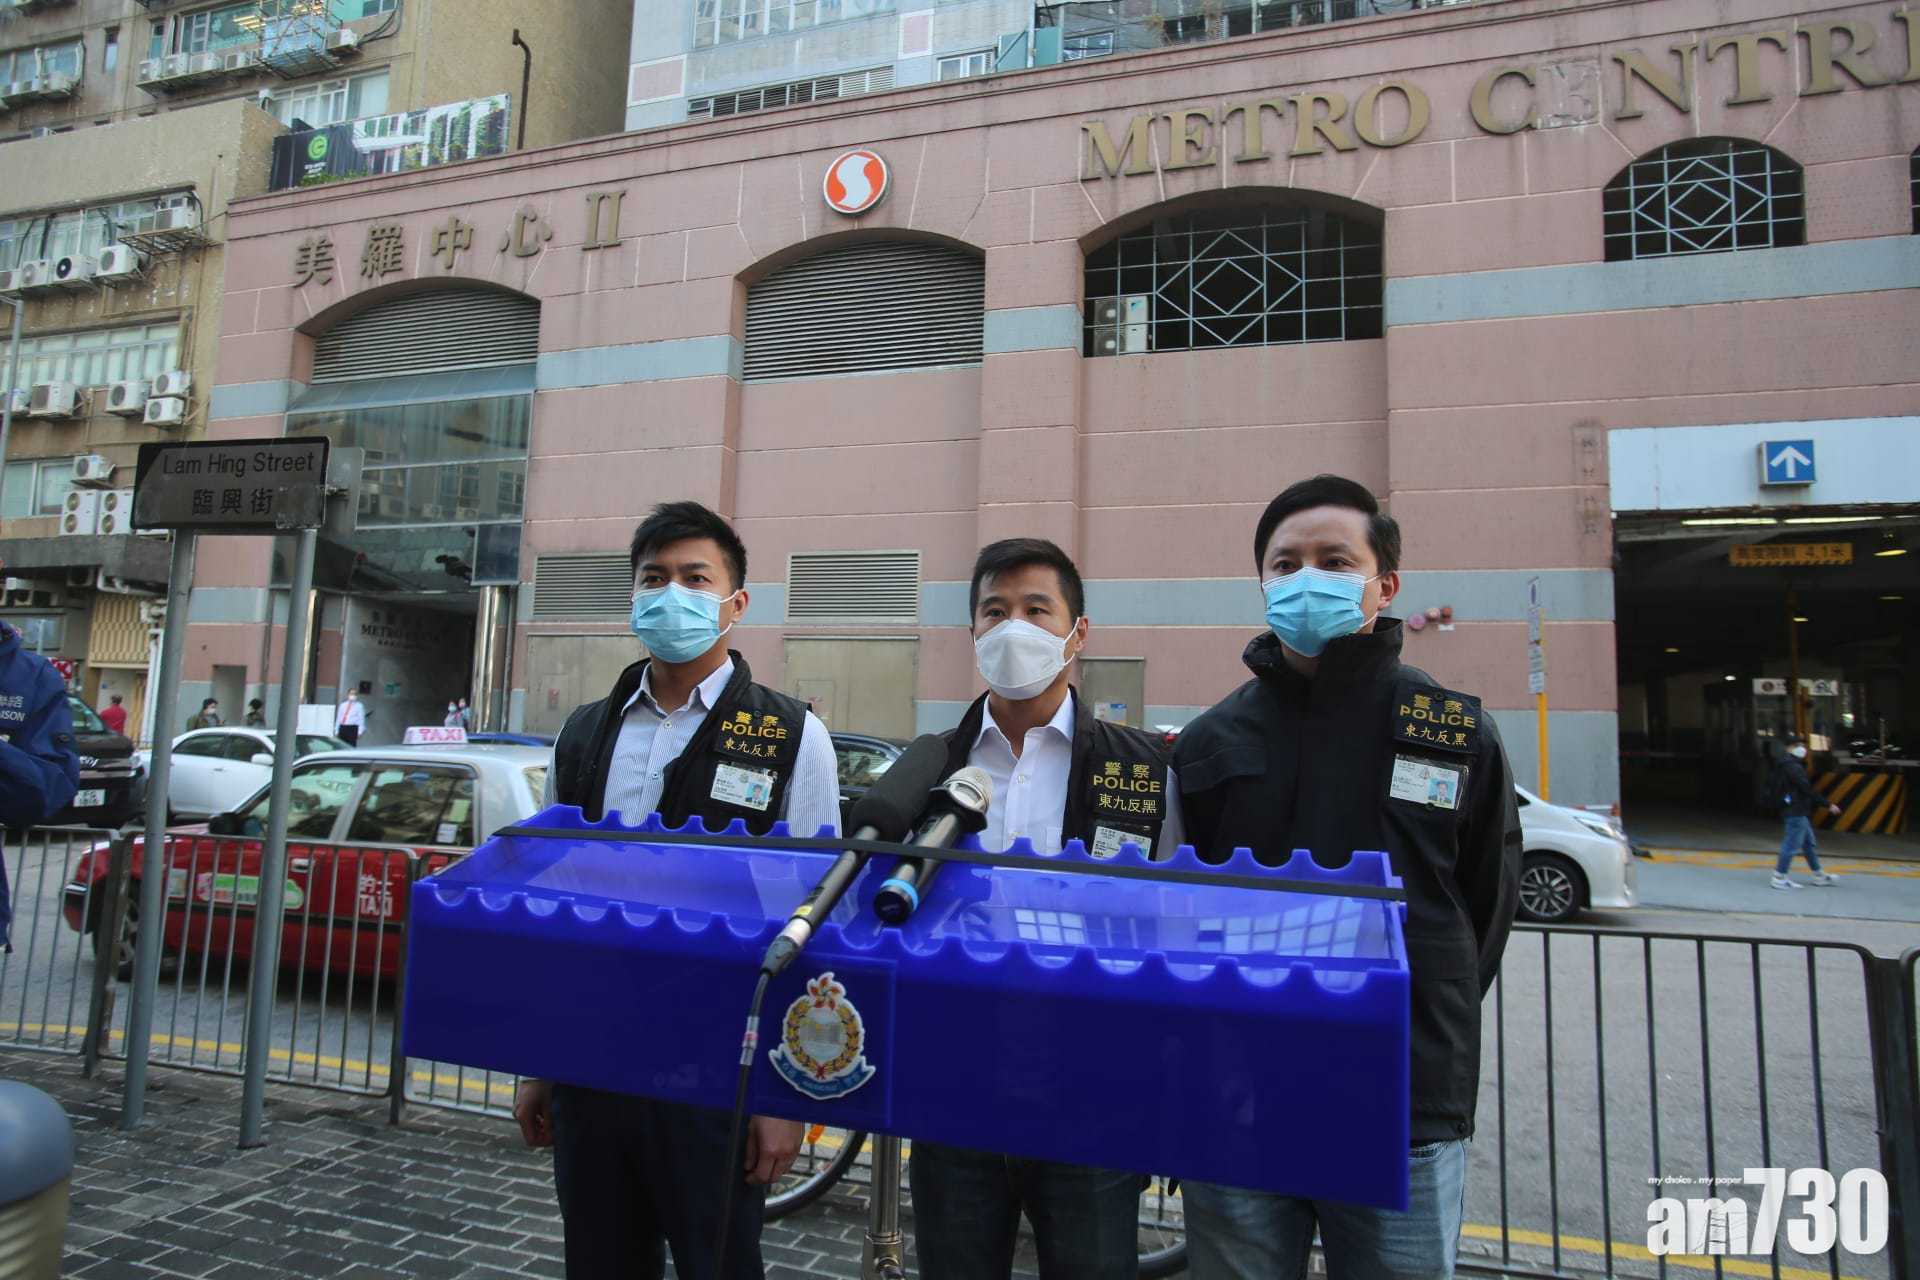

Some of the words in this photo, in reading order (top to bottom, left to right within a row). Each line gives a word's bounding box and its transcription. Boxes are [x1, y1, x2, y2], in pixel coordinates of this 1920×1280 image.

[1080, 79, 1431, 180] METRO
[1468, 9, 1920, 135] CNTR
[163, 455, 201, 475] Lam
[208, 454, 246, 478] Hing
[253, 452, 314, 473] Street
[191, 488, 273, 515] 臨興街
[1413, 694, 1463, 713] 警察
[735, 711, 779, 727] 警察
[1400, 704, 1476, 728] POLICE
[419, 728, 465, 741] TAXI
[721, 720, 788, 739] POLICE
[1405, 723, 1468, 747] 東九反黑
[724, 737, 777, 758] 東九反黑
[1104, 761, 1150, 778] 警察
[1093, 775, 1161, 793] POLICE
[1099, 793, 1158, 814] 東九反黑
